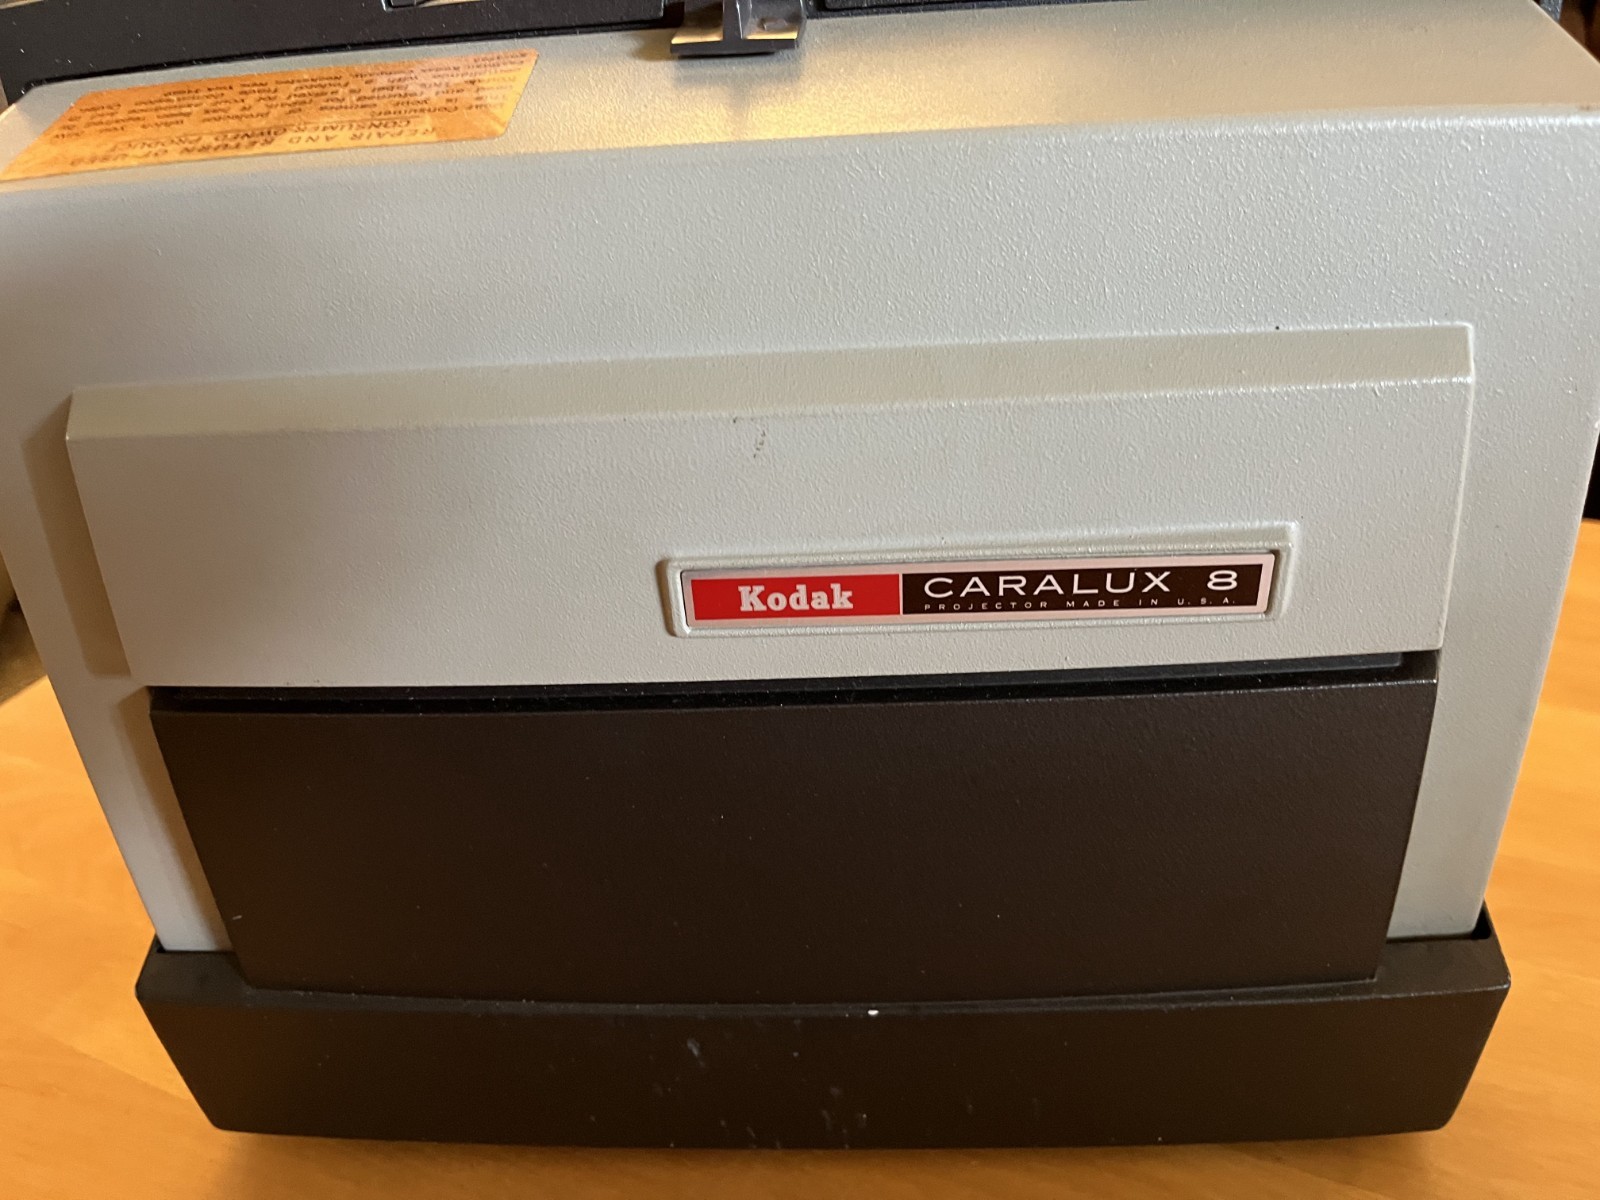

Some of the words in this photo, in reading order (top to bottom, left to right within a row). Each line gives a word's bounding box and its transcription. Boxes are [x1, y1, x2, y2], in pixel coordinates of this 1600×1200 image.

[284, 133, 338, 144] AND
[924, 570, 1171, 599] CARALUX
[1206, 569, 1238, 592] 8
[738, 582, 853, 613] Kodak
[924, 601, 1048, 611] PROJECTOR
[1066, 599, 1120, 608] MADE
[1138, 598, 1158, 606] IN
